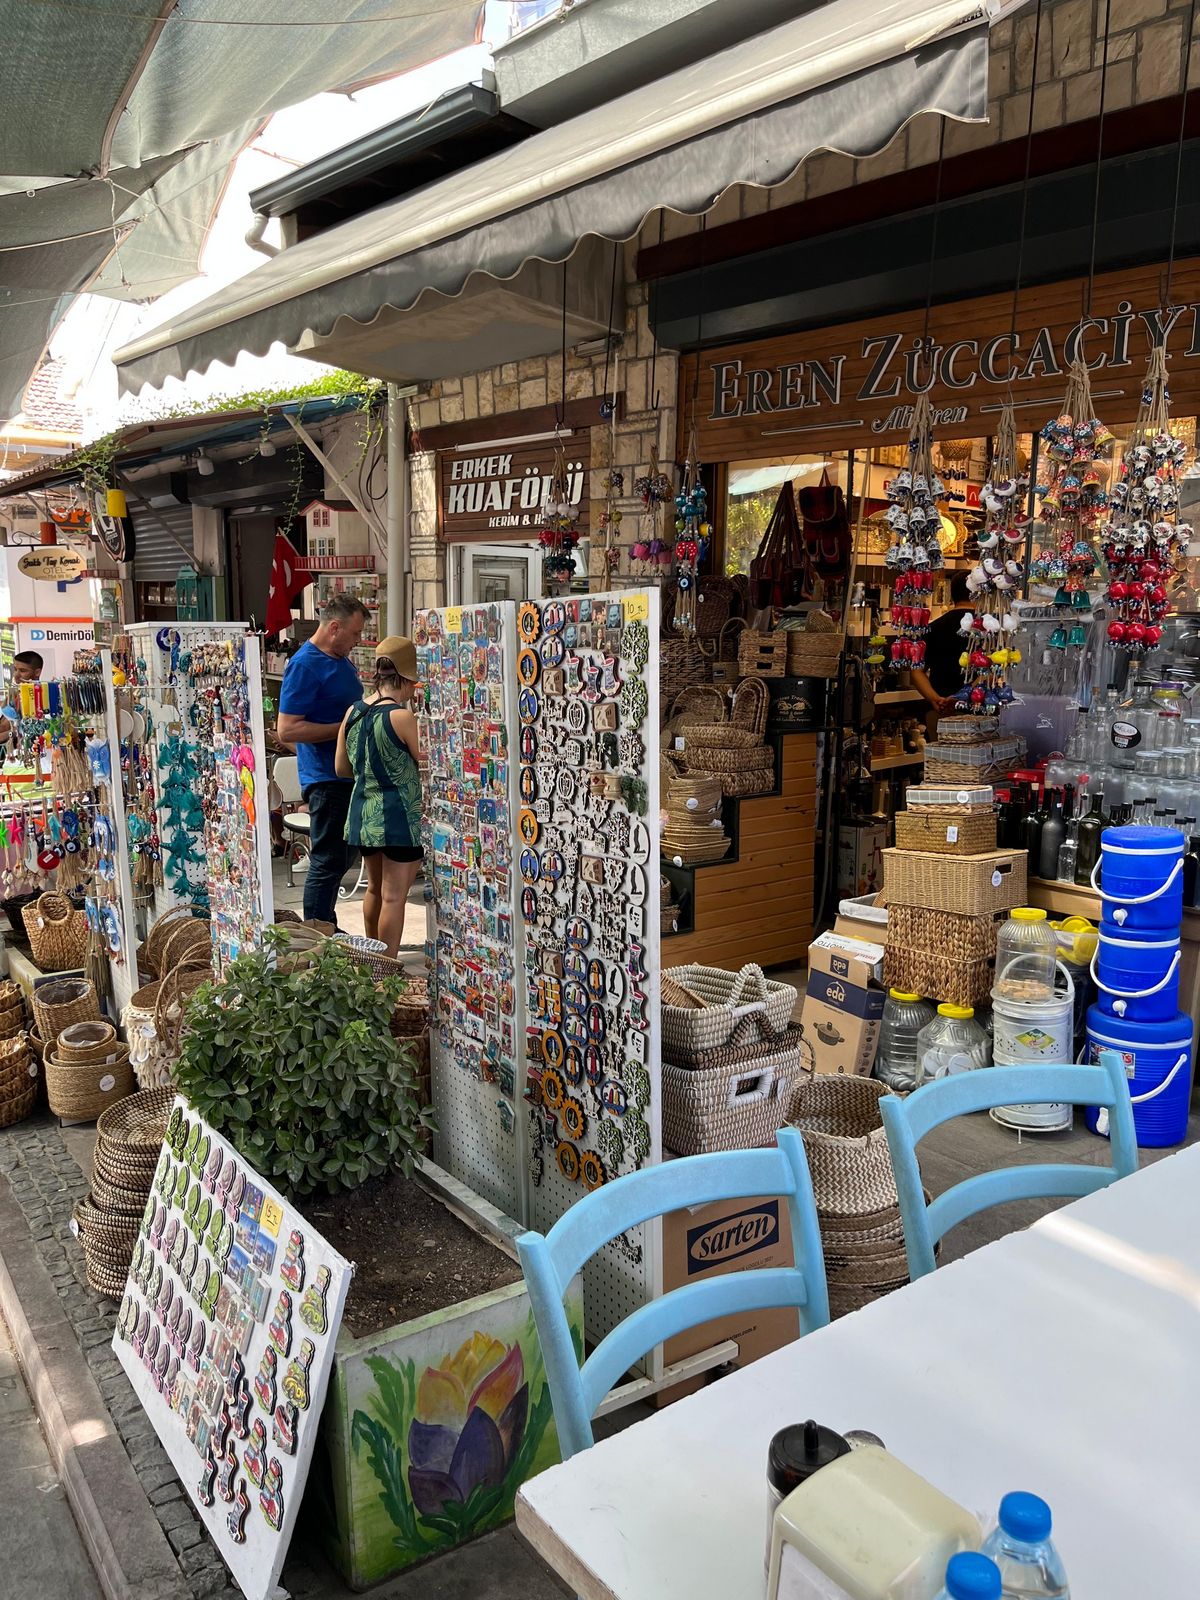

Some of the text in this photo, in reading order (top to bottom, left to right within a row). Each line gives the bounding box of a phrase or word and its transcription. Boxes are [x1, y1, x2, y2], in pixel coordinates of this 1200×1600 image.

[707, 355, 847, 421] EREN
[871, 403, 968, 434] Ali ren
[451, 454, 513, 481] ERKEK
[488, 512, 520, 528] KERİM
[522, 514, 531, 525] &
[627, 601, 634, 615] 10
[826, 986, 845, 1002] eda
[699, 1215, 769, 1259] sarten
